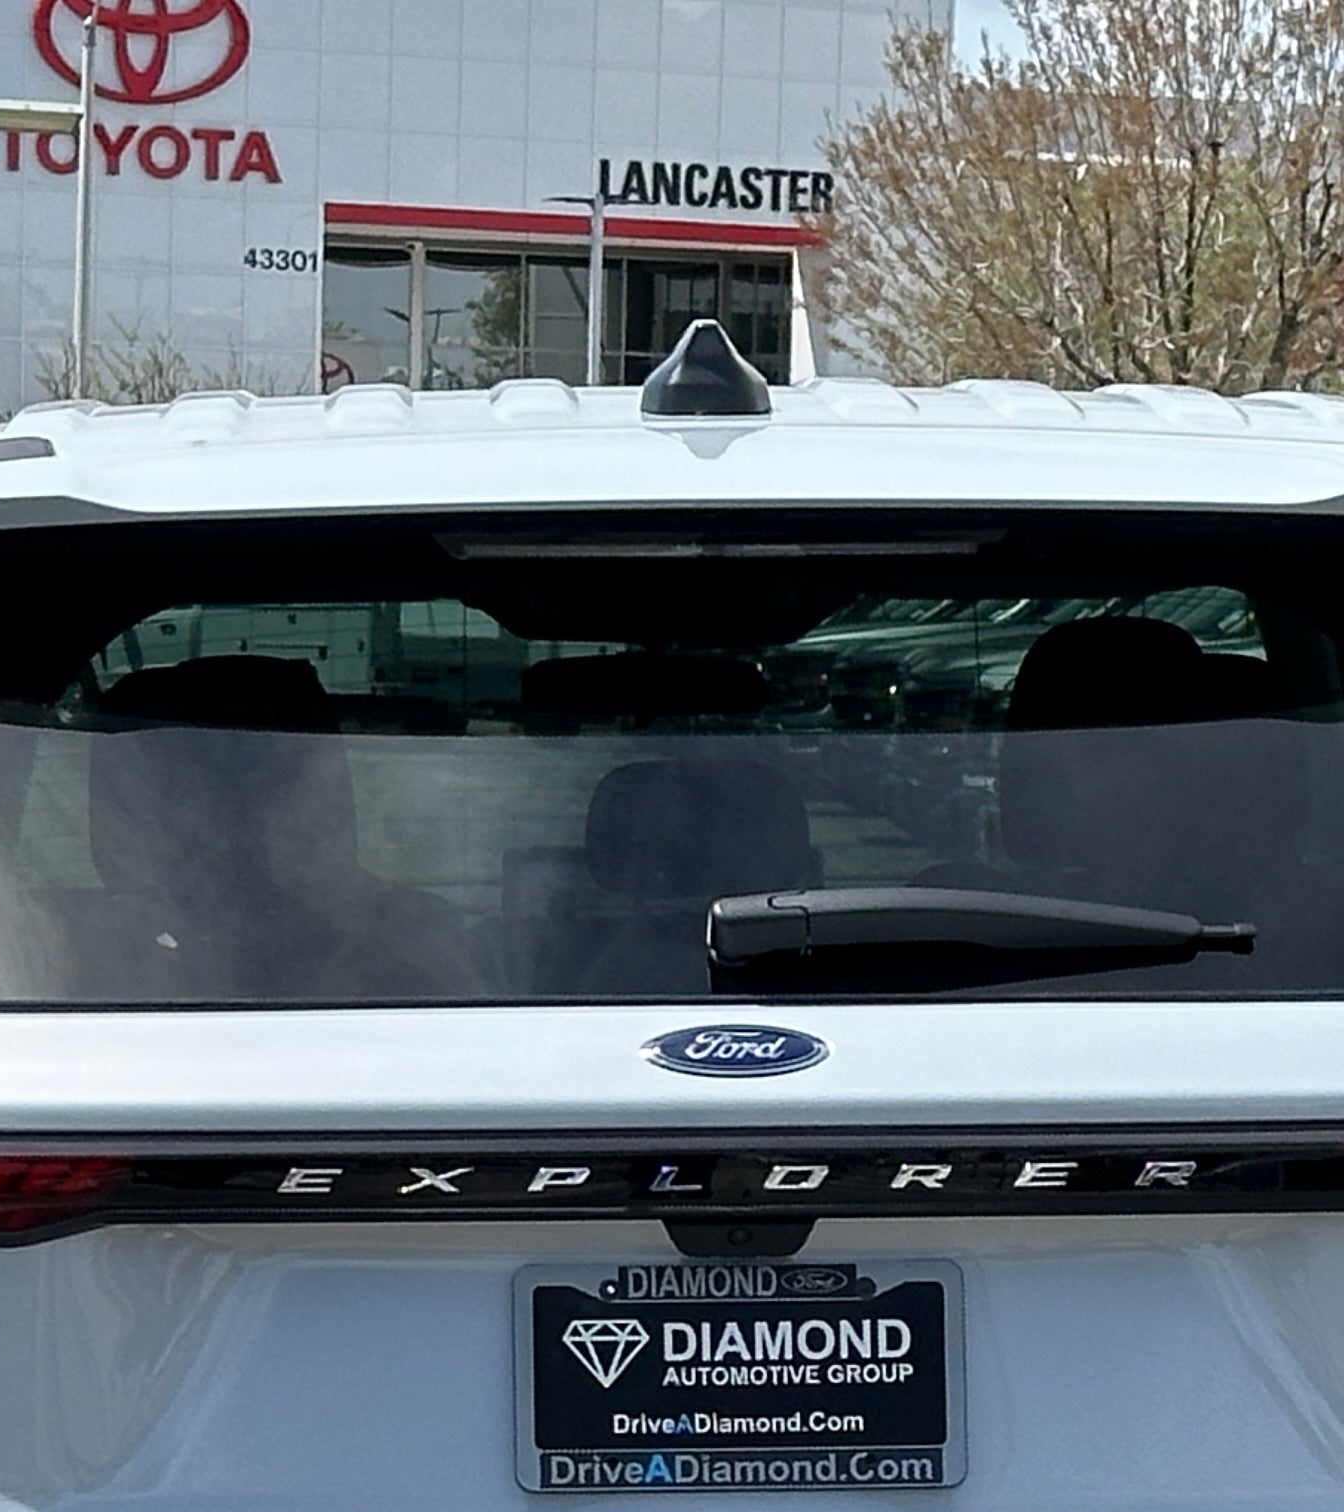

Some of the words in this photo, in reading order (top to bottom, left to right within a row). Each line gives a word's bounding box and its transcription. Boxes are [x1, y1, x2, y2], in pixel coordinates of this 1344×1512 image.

[5, 123, 283, 184] TOYOTA
[599, 158, 835, 215] LANCASTER
[243, 247, 318, 273] 43301
[685, 1031, 787, 1060] Ford
[276, 1161, 1197, 1193] EXPLORER
[626, 1266, 779, 1299] DIAMOND
[662, 1319, 912, 1363] DIAMOND
[662, 1366, 821, 1388] AUTOMOTIVE
[827, 1363, 915, 1384] GROUP
[612, 1411, 865, 1435] DriveADiamond.Com
[549, 1452, 934, 1486] DriveADiamond.Com
